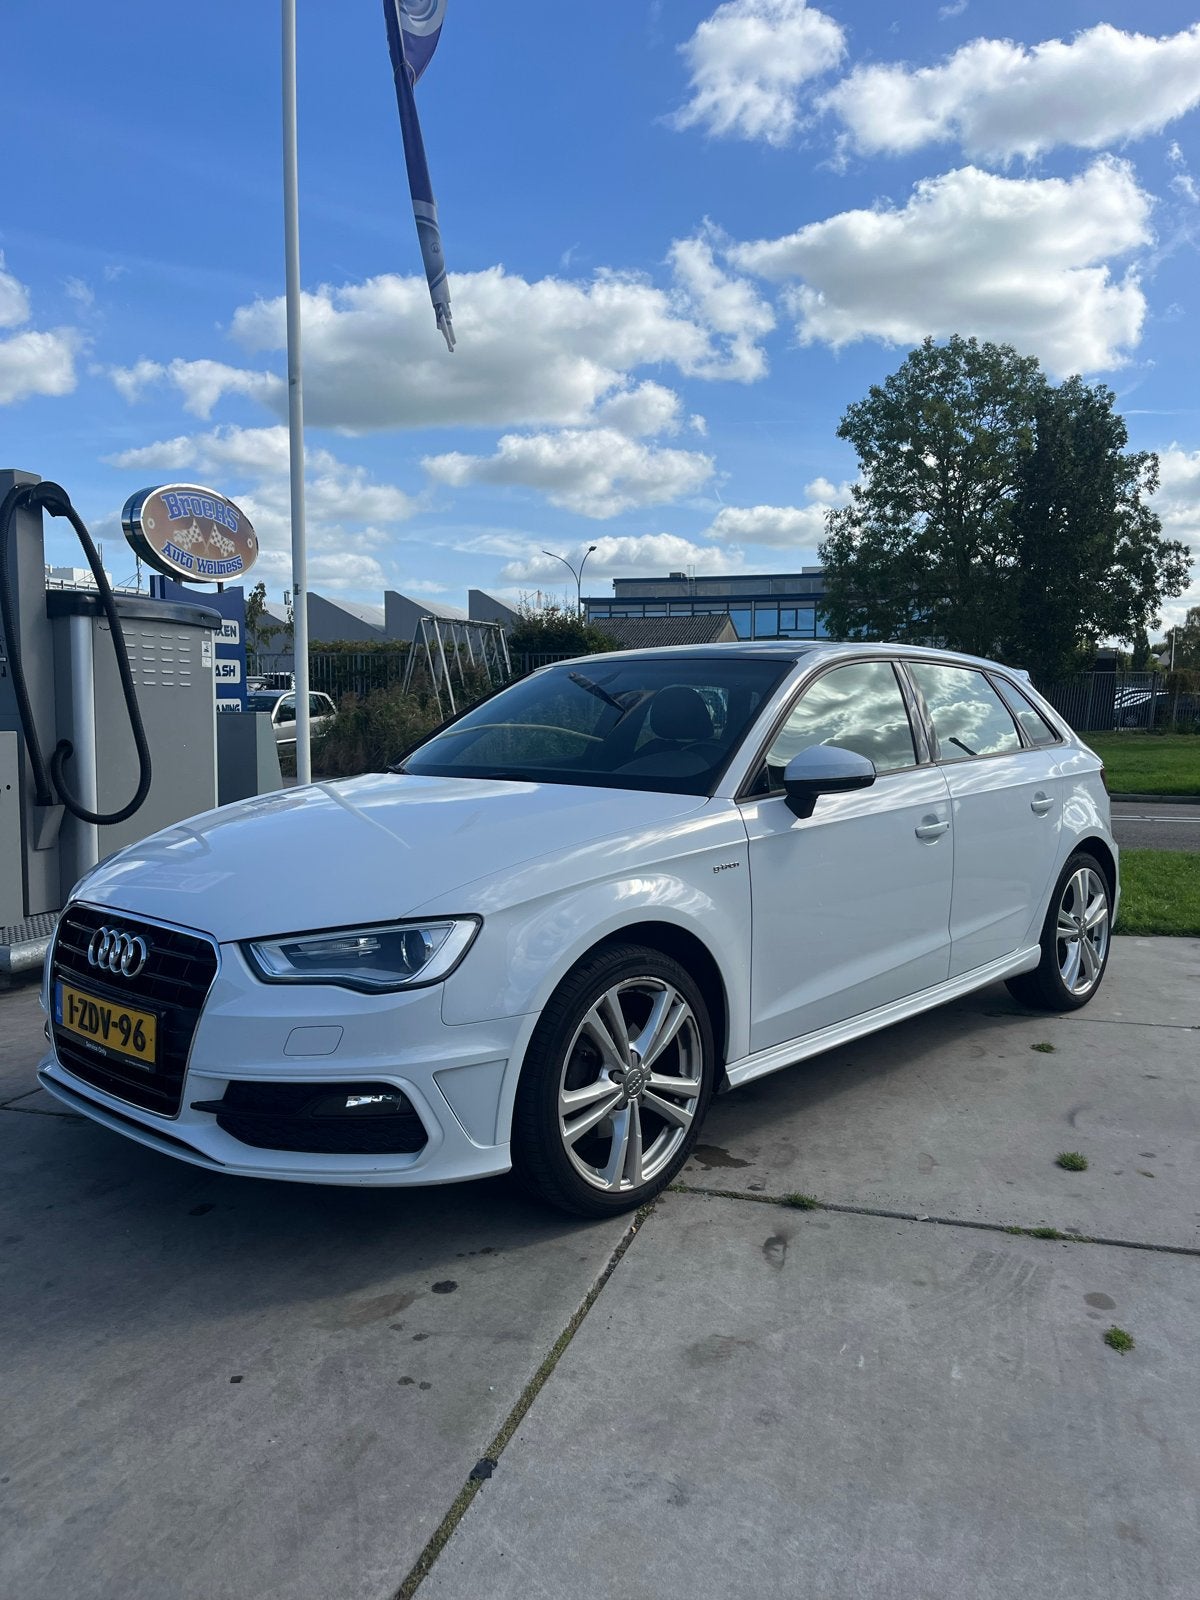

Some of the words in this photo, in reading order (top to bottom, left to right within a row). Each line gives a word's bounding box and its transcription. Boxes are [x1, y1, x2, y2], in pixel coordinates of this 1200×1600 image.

[161, 541, 194, 569] Auto
[196, 555, 243, 575] Wellness
[215, 664, 235, 677] ASH
[216, 704, 240, 712] ANING
[68, 994, 146, 1052] 1-ZDV-96
